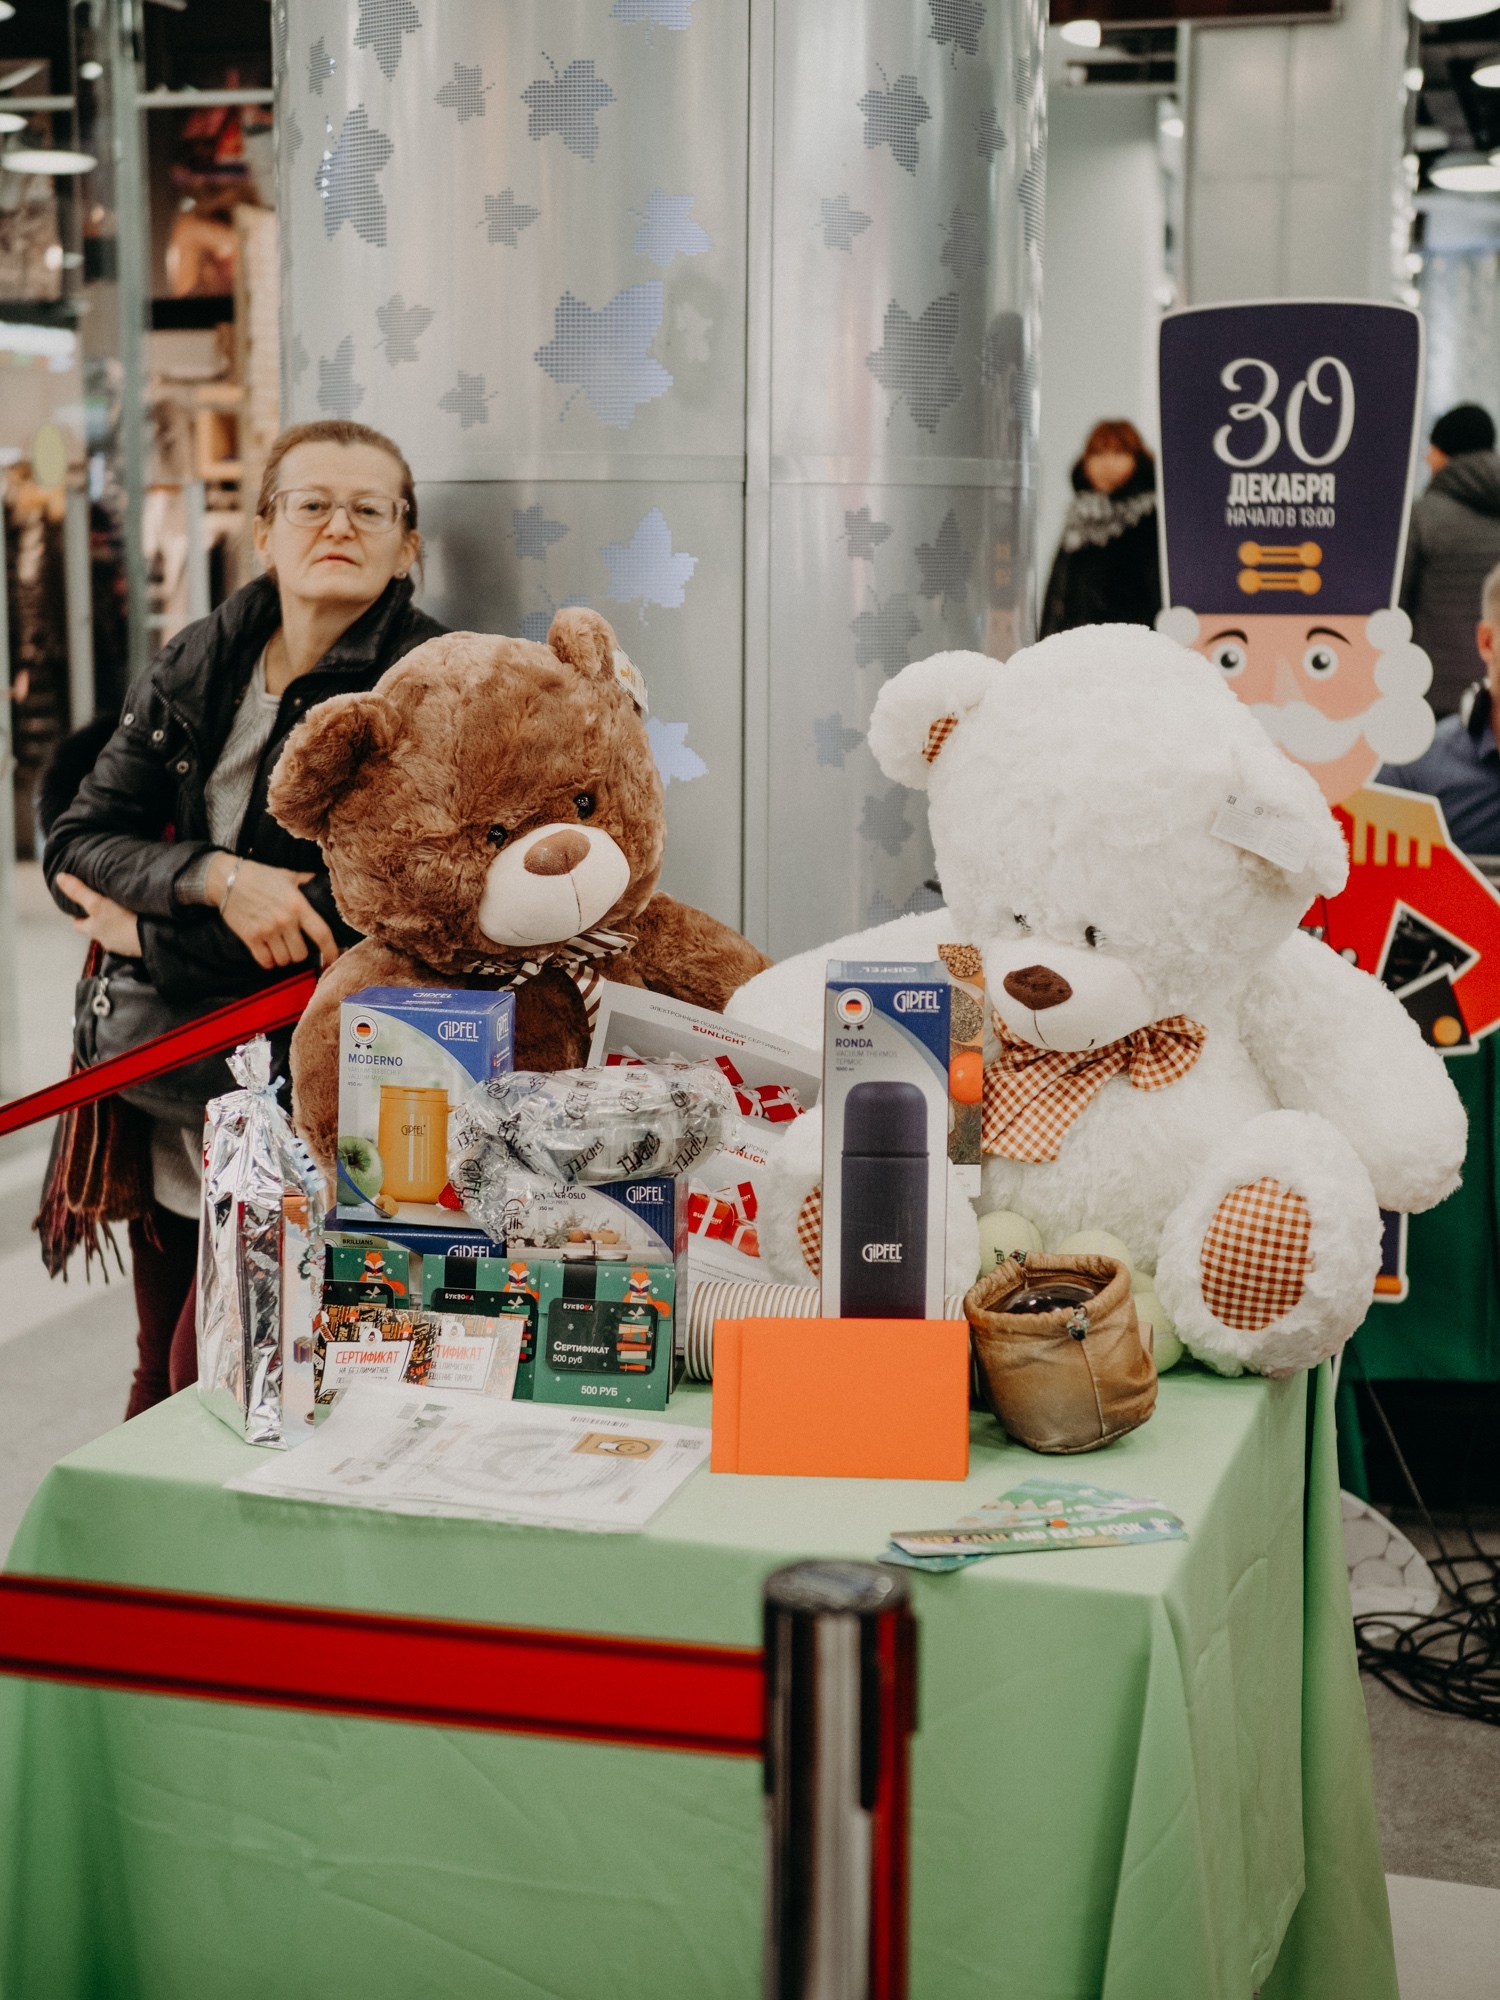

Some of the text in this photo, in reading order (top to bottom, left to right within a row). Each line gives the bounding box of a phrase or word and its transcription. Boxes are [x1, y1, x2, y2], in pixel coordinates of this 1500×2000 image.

[1213, 356, 1355, 468] 30
[1227, 473, 1335, 505] ДЕКАБРЯ
[1225, 506, 1283, 527] НАЧАЛО
[1284, 507, 1297, 527] В
[650, 1004, 790, 1055] ЭЛЕКТРОННЫЙ ПОДАРОЧНЫЙ СЕРТИФИКАТ
[692, 1025, 746, 1046] SUNLIGHT
[835, 1038, 873, 1048] RONDA
[348, 1053, 403, 1067] MODERNO
[342, 1238, 373, 1246] BRILLIANS
[335, 1350, 400, 1365] СЕРТИФИКАТ
[552, 1354, 583, 1364] 500 руб
[348, 1366, 391, 1375] БЕЗЛИМИТНОЕ
[581, 1385, 618, 1396] 500 РУБ
